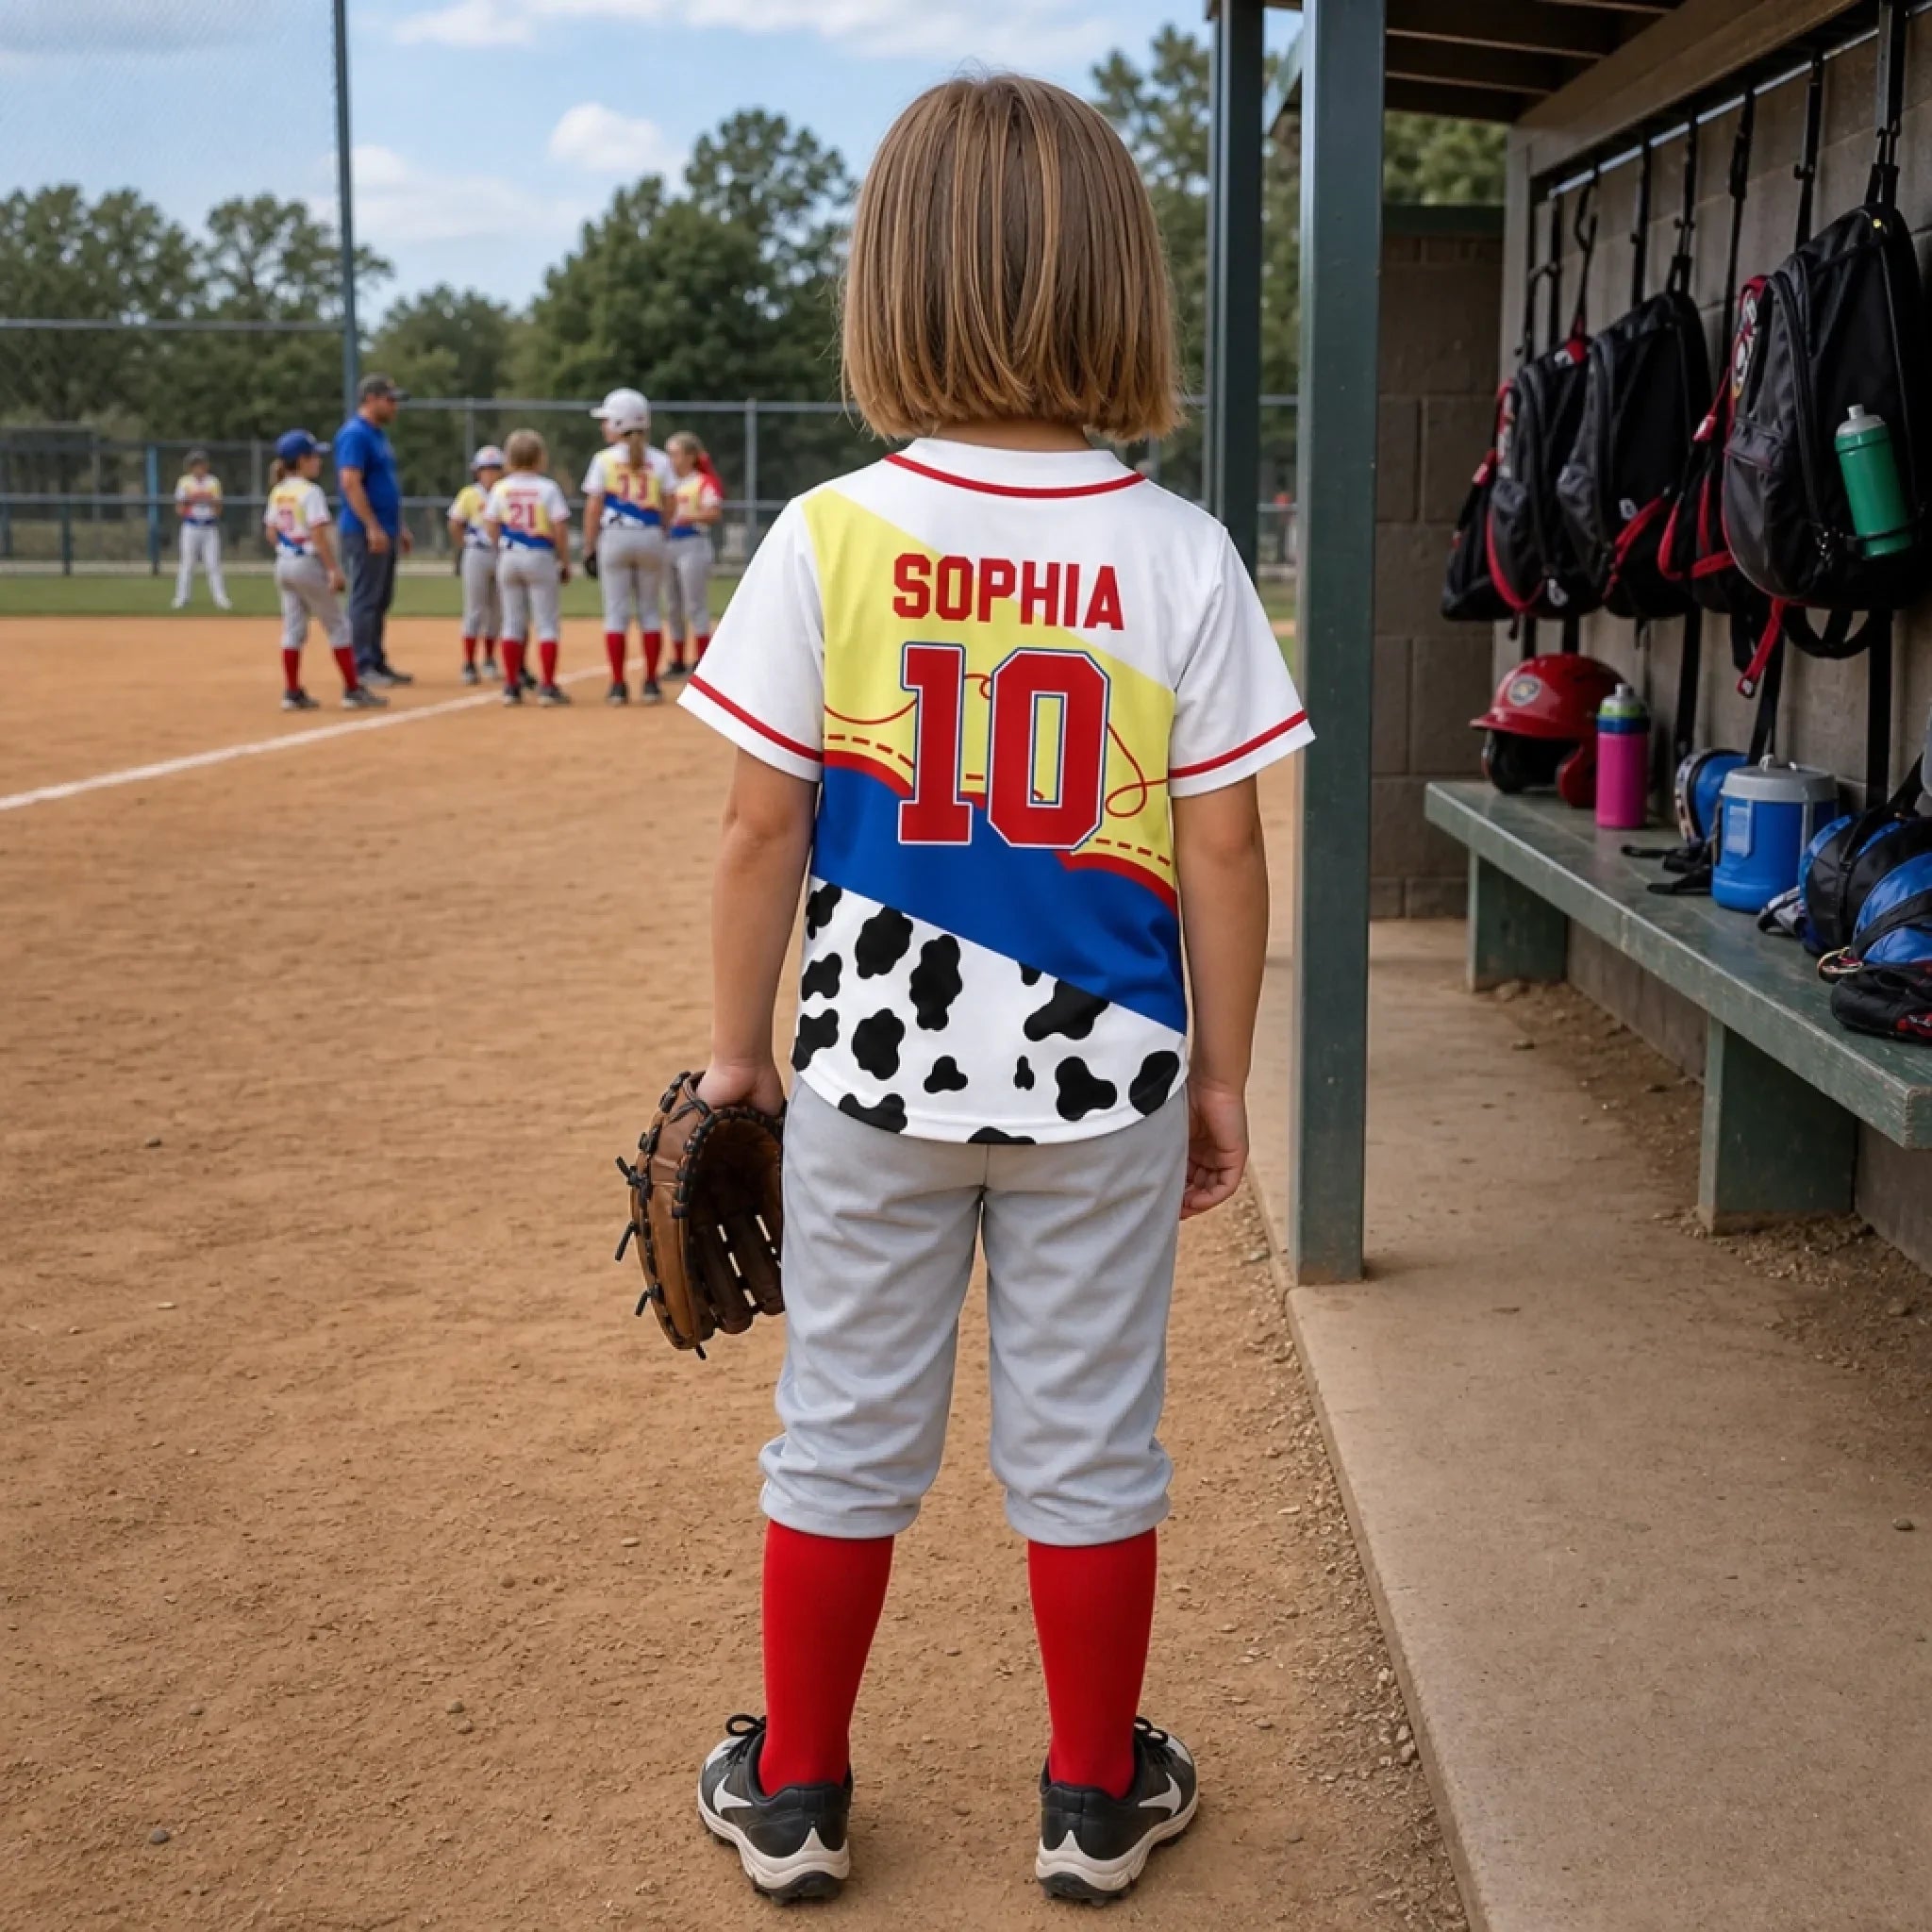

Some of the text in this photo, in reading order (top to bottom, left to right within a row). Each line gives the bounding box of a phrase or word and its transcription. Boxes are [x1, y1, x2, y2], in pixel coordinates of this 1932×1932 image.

[509, 502, 537, 530] 21
[892, 552, 1124, 630] SOPHIA
[898, 641, 1111, 851] 10
